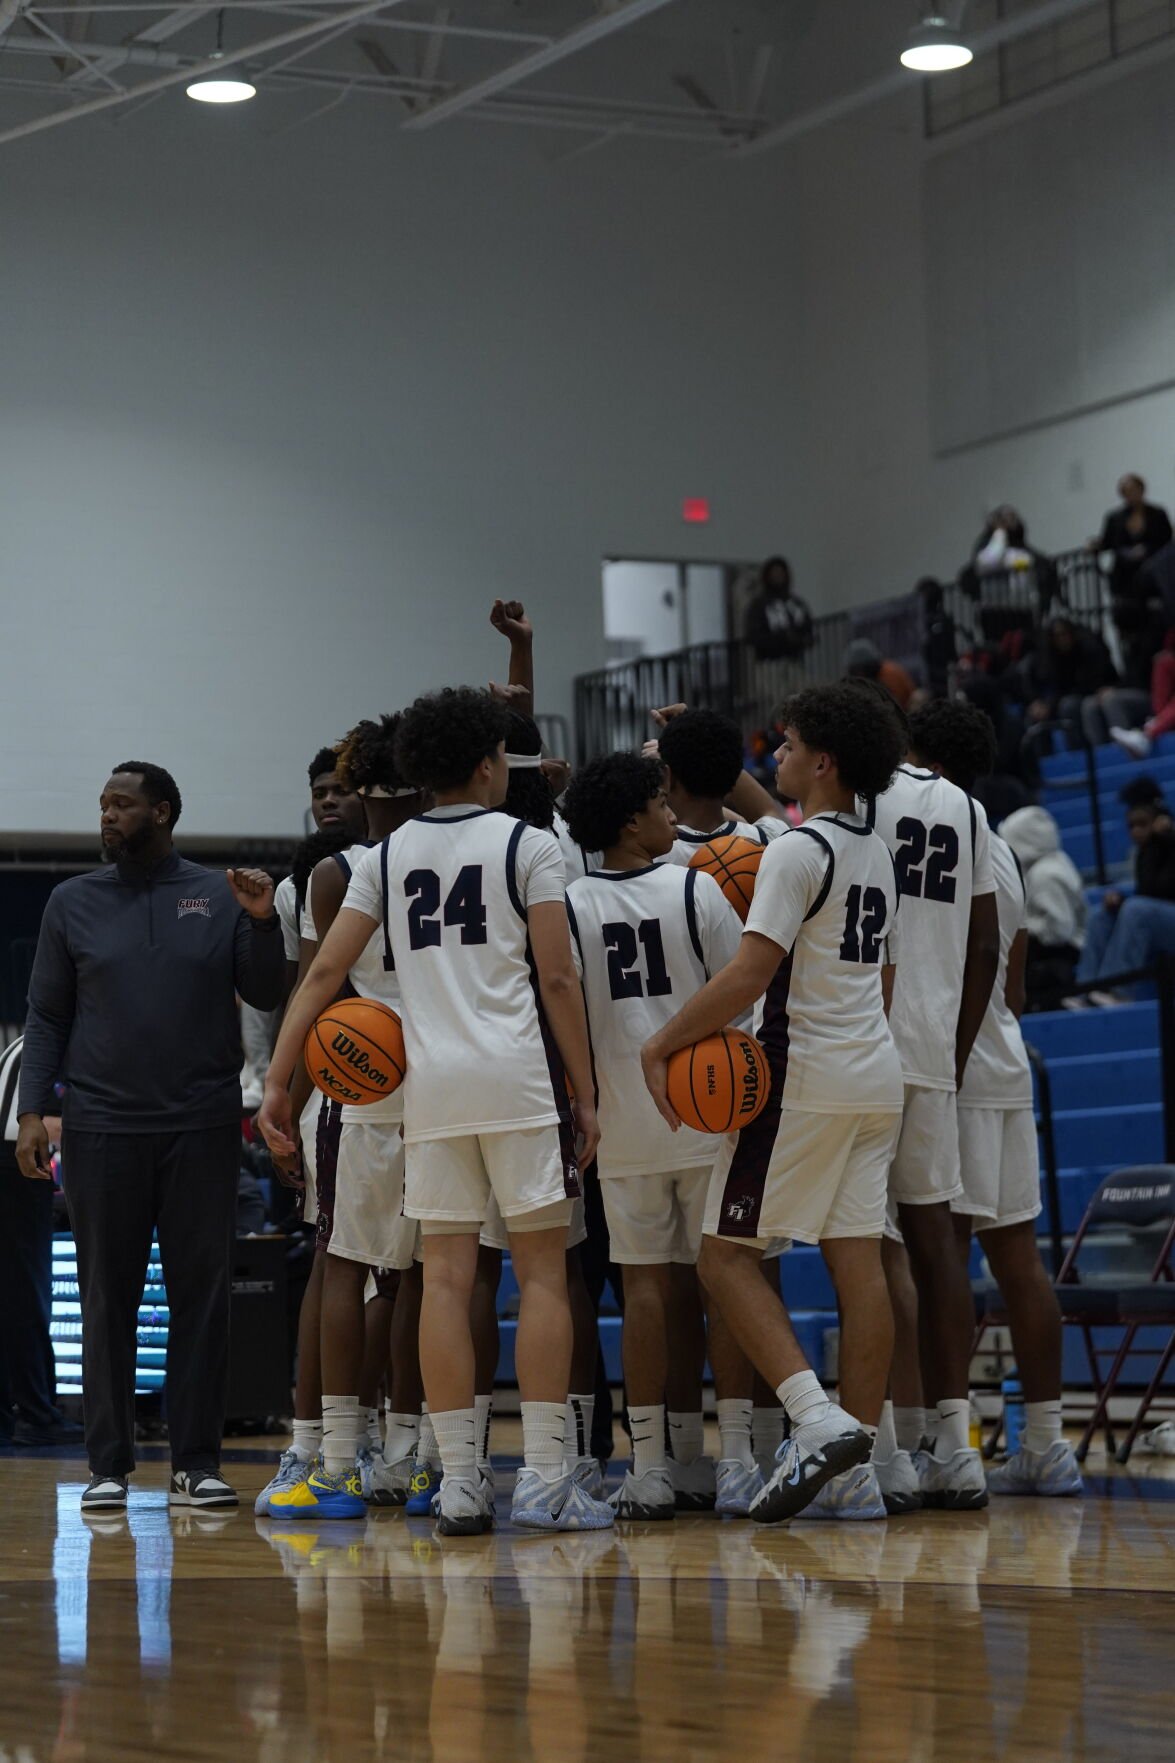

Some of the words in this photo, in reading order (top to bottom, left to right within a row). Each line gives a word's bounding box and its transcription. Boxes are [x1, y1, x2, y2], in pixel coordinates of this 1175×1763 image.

[895, 816, 959, 904] 22
[178, 898, 210, 909] FURY
[404, 864, 487, 950] 24
[839, 884, 886, 963] 12
[602, 918, 672, 1000] 21
[318, 1067, 362, 1101] NCAA
[331, 1029, 389, 1087] Wilson
[739, 1041, 759, 1114] Wilson
